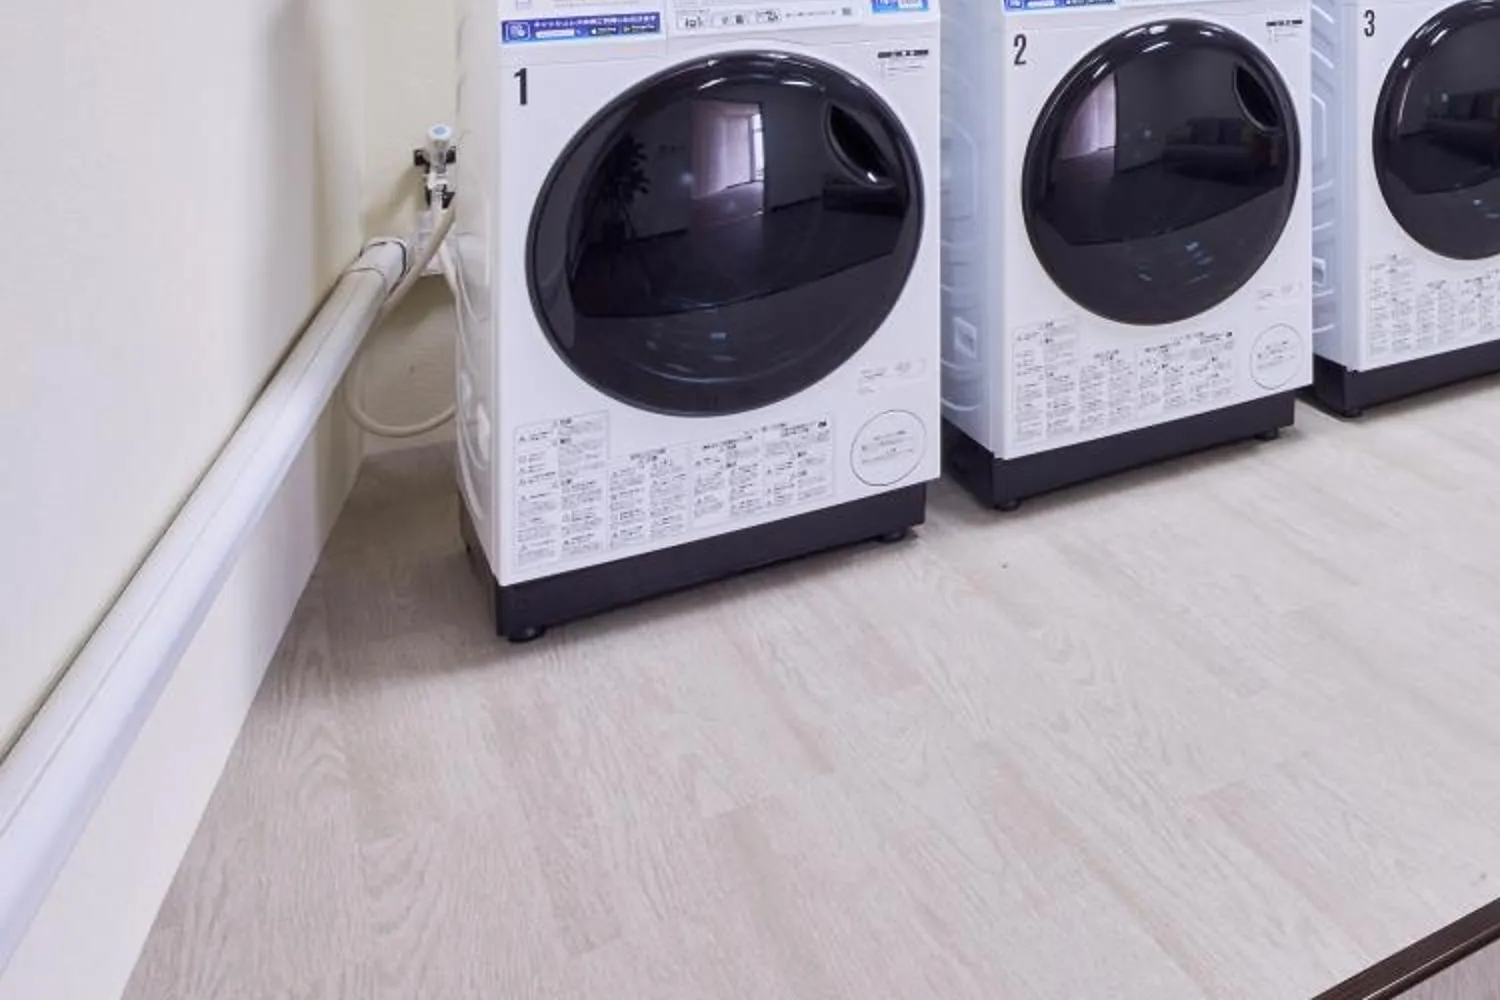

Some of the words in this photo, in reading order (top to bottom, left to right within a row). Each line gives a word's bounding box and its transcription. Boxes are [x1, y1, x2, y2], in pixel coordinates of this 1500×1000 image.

[1363, 9, 1376, 37] 3
[1013, 34, 1027, 65] 2
[513, 67, 528, 105] 1
